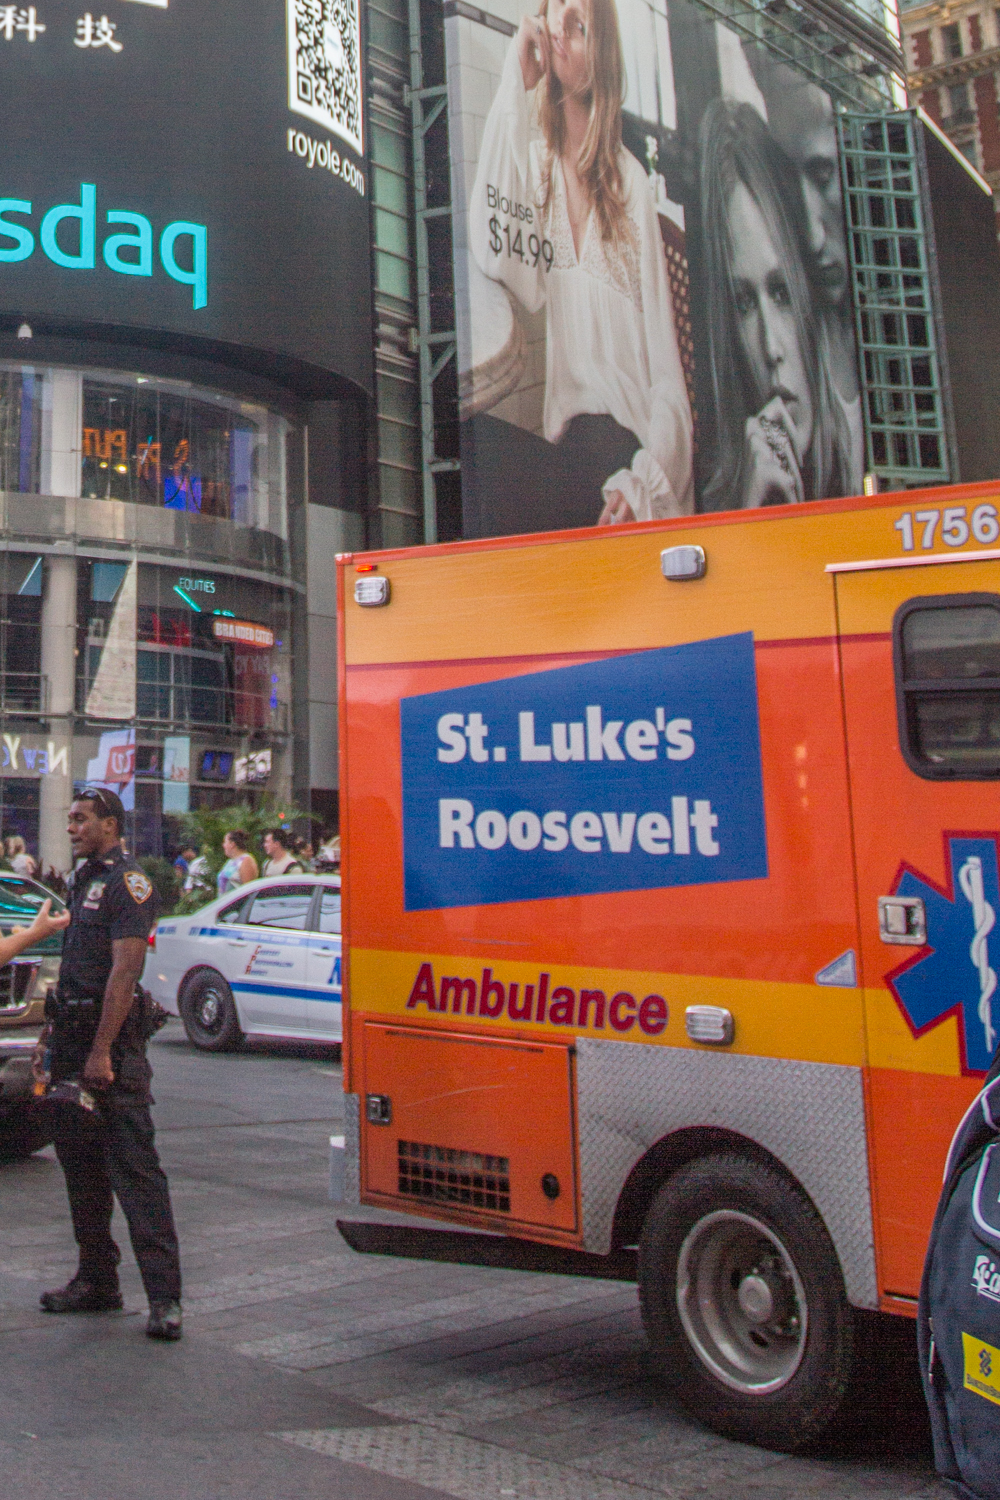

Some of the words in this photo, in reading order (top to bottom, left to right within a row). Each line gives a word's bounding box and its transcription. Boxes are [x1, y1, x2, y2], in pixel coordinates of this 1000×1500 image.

[287, 128, 365, 197] royole.com
[487, 183, 534, 225] Blouse
[489, 213, 554, 274] $14.99
[894, 503, 1000, 551] 1756
[179, 577, 216, 594] EQUITIES
[215, 622, 254, 641] BRANDED
[437, 712, 507, 763] St.
[519, 705, 695, 762] Luke's
[439, 796, 720, 857] Roosevelt
[406, 962, 670, 1035] Ambulance
